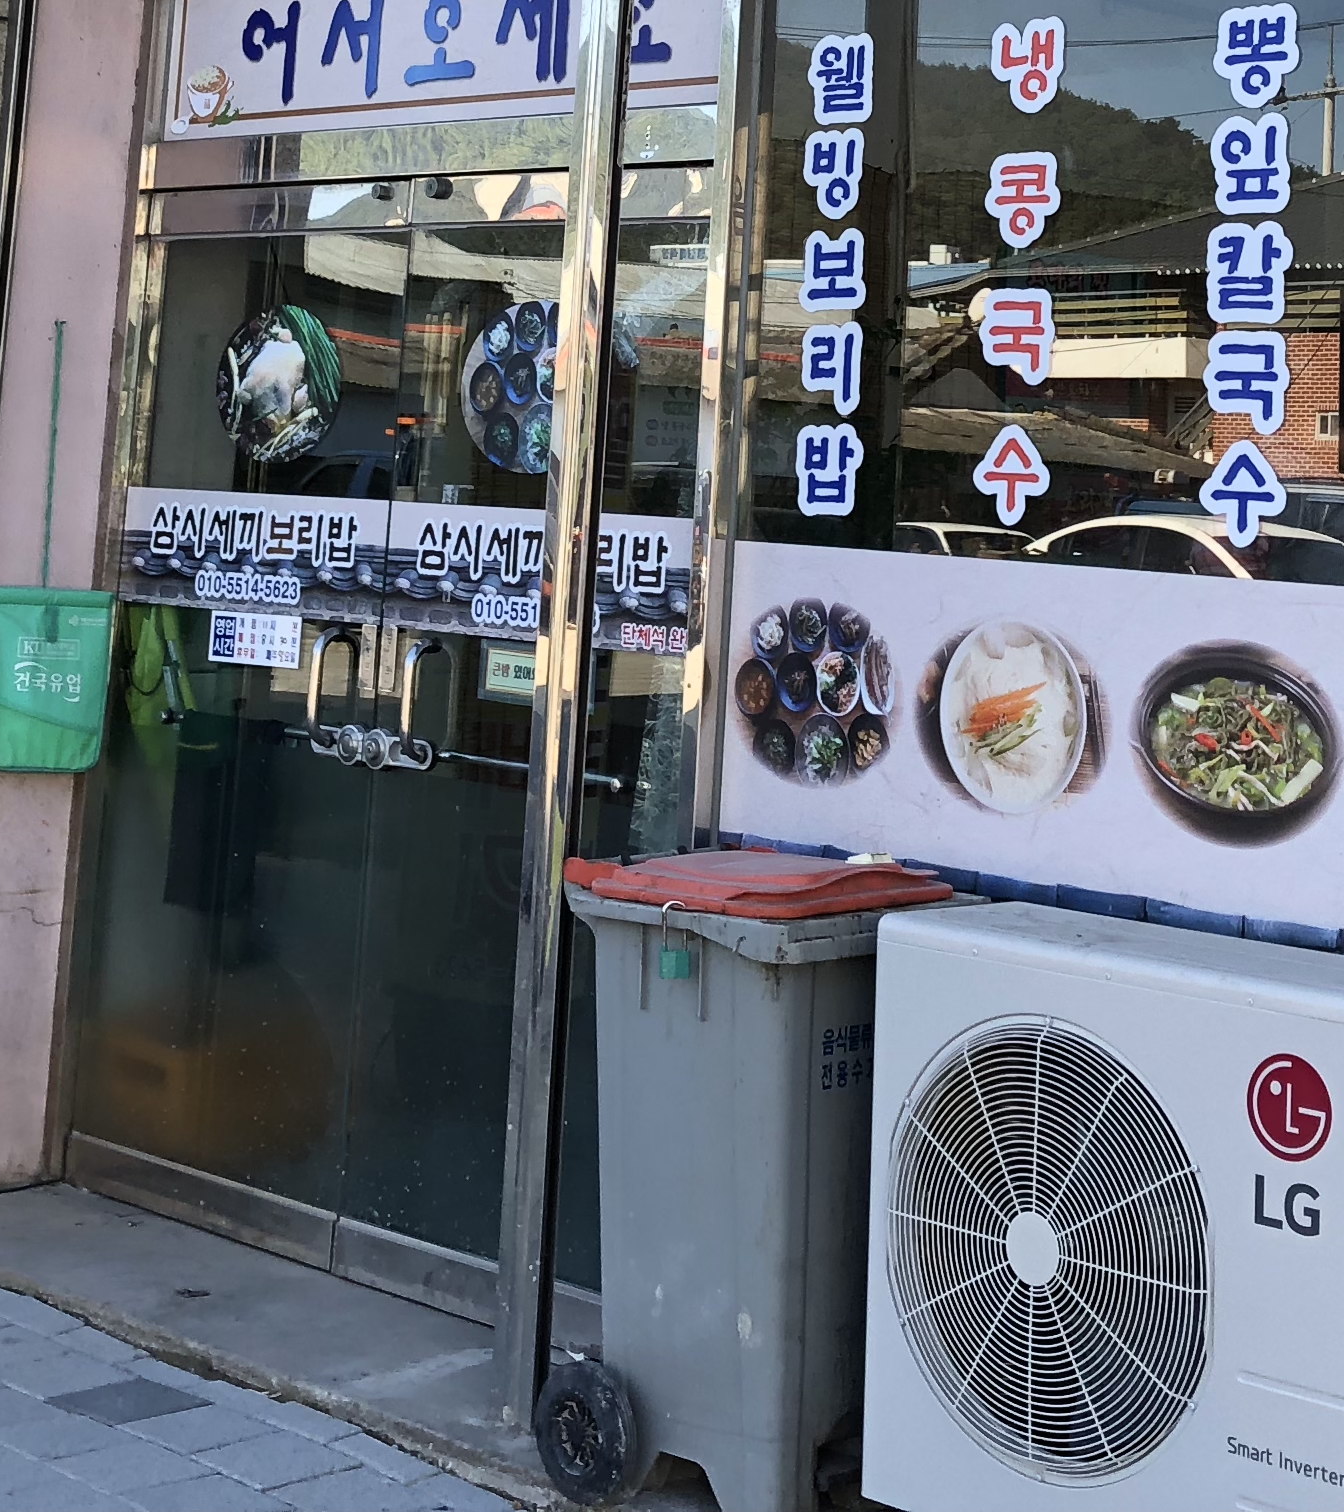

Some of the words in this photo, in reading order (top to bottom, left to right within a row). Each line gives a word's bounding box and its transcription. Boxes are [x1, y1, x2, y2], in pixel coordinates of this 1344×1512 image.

[982, 27, 1056, 513] 냉콩국수
[1209, 14, 1290, 533] 뽕잎칼국수
[197, 574, 299, 600] 010-5514-5623
[215, 618, 236, 636] 영업
[621, 623, 667, 651] 단체석
[669, 627, 688, 652] 완
[213, 637, 235, 655] 시간
[13, 671, 82, 694] 건국유업
[1254, 1174, 1320, 1236] LG
[1227, 1436, 1272, 1466] Smart
